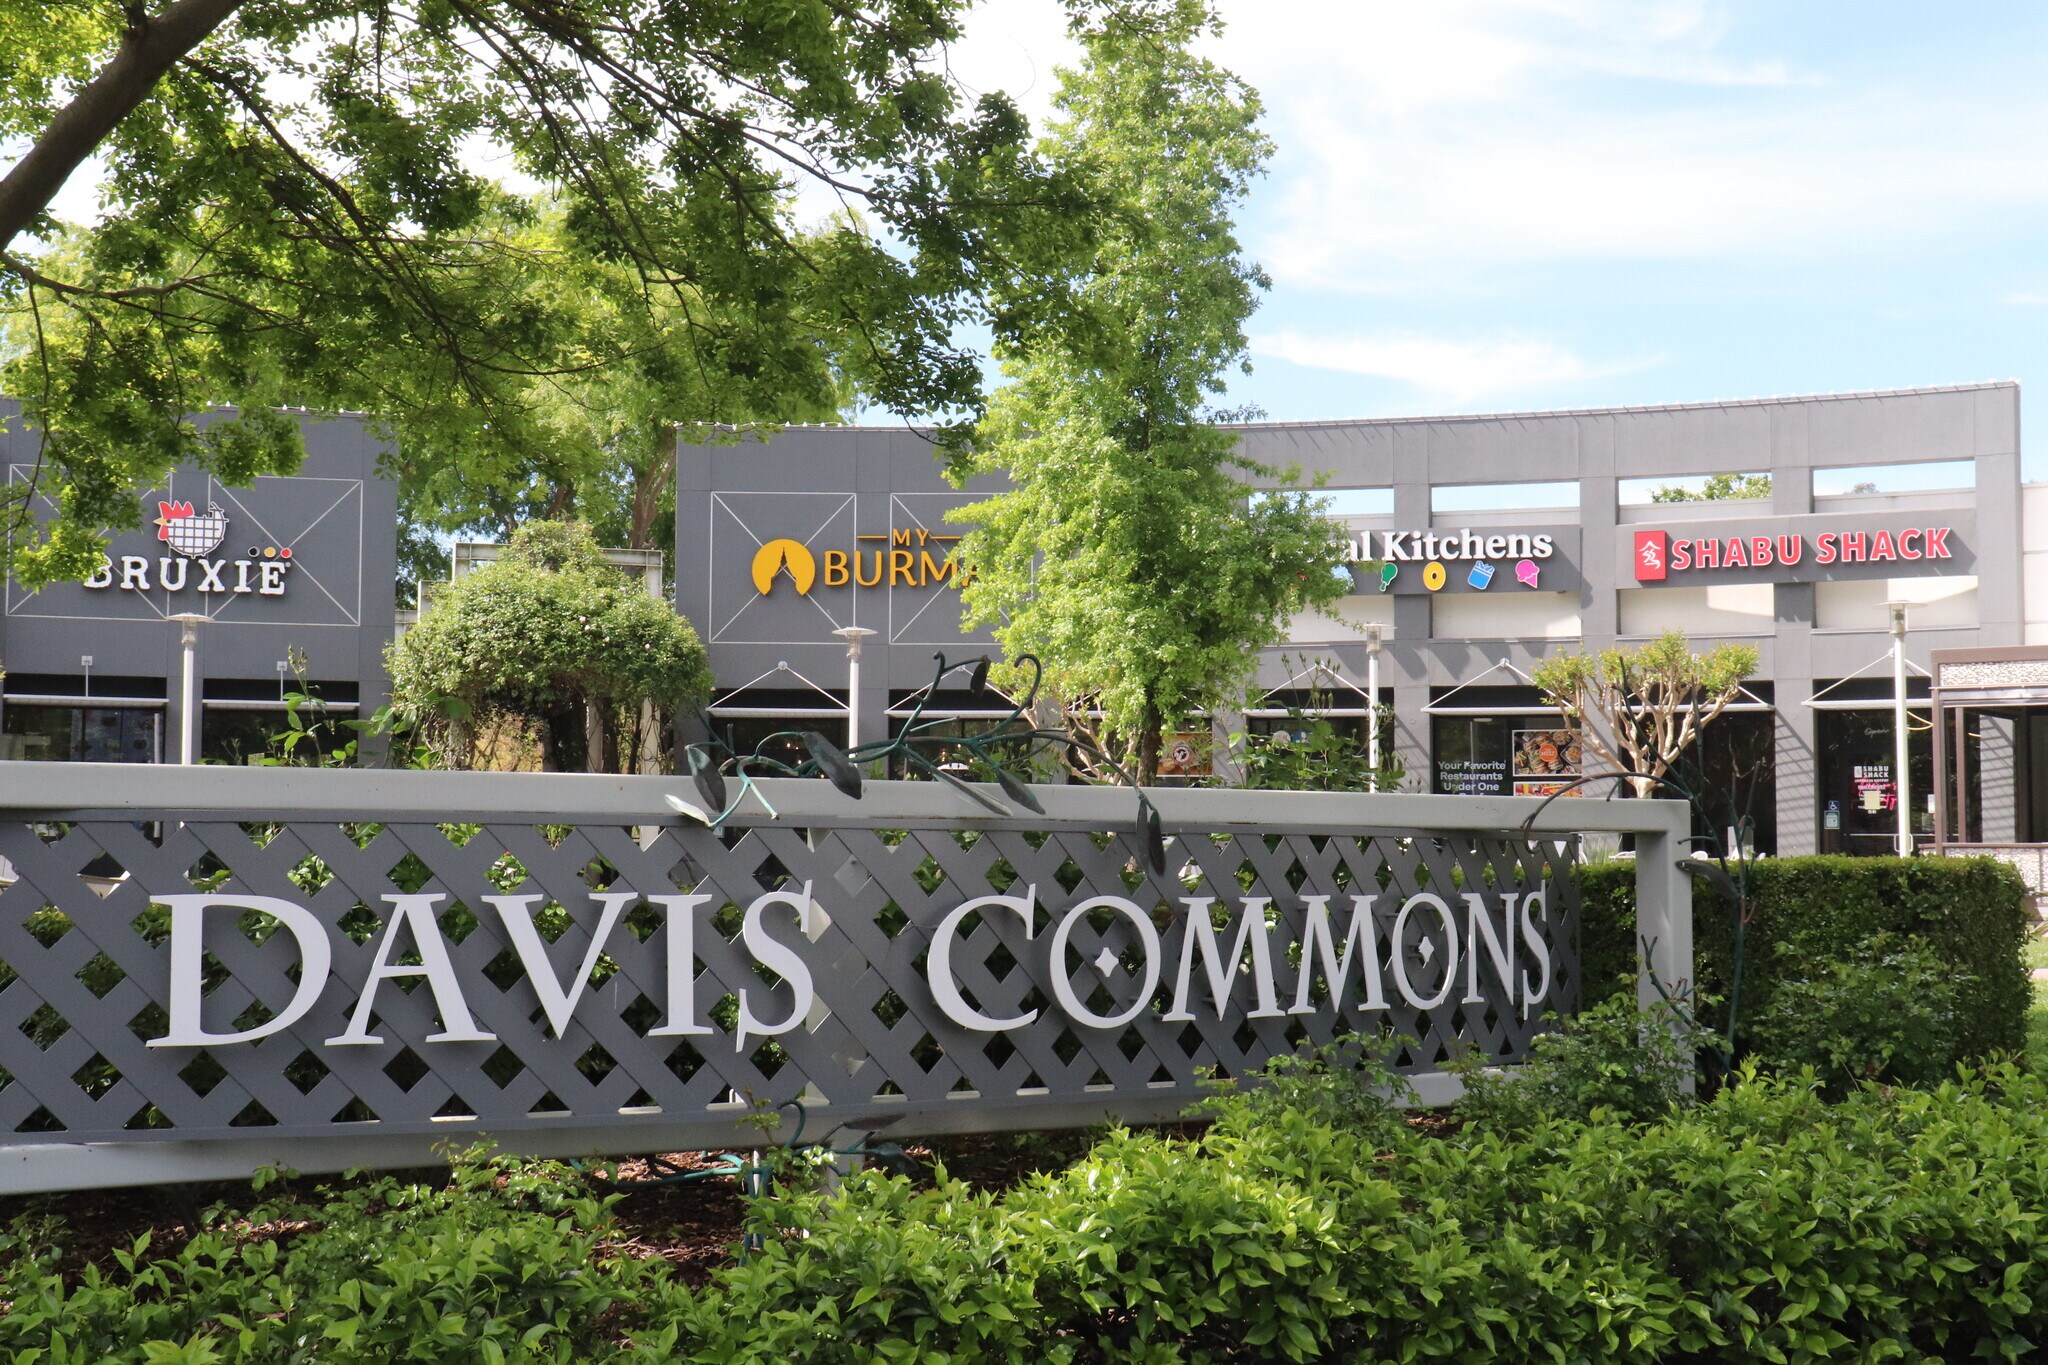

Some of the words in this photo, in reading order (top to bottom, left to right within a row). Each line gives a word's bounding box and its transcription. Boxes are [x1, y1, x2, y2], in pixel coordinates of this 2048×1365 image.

[892, 528, 930, 547] MY
[1381, 528, 1553, 561] Kitchens
[1671, 534, 1802, 570] SHABU
[1815, 527, 1952, 564] SHACK
[83, 555, 286, 595] BRUXIE
[1438, 760, 1462, 770] Your
[1463, 760, 1506, 770] Favorite
[1440, 772, 1503, 780] Restaurants
[1478, 782, 1500, 791] One
[145, 878, 814, 1053] DAVIS
[927, 878, 1550, 1032] COMMONS
